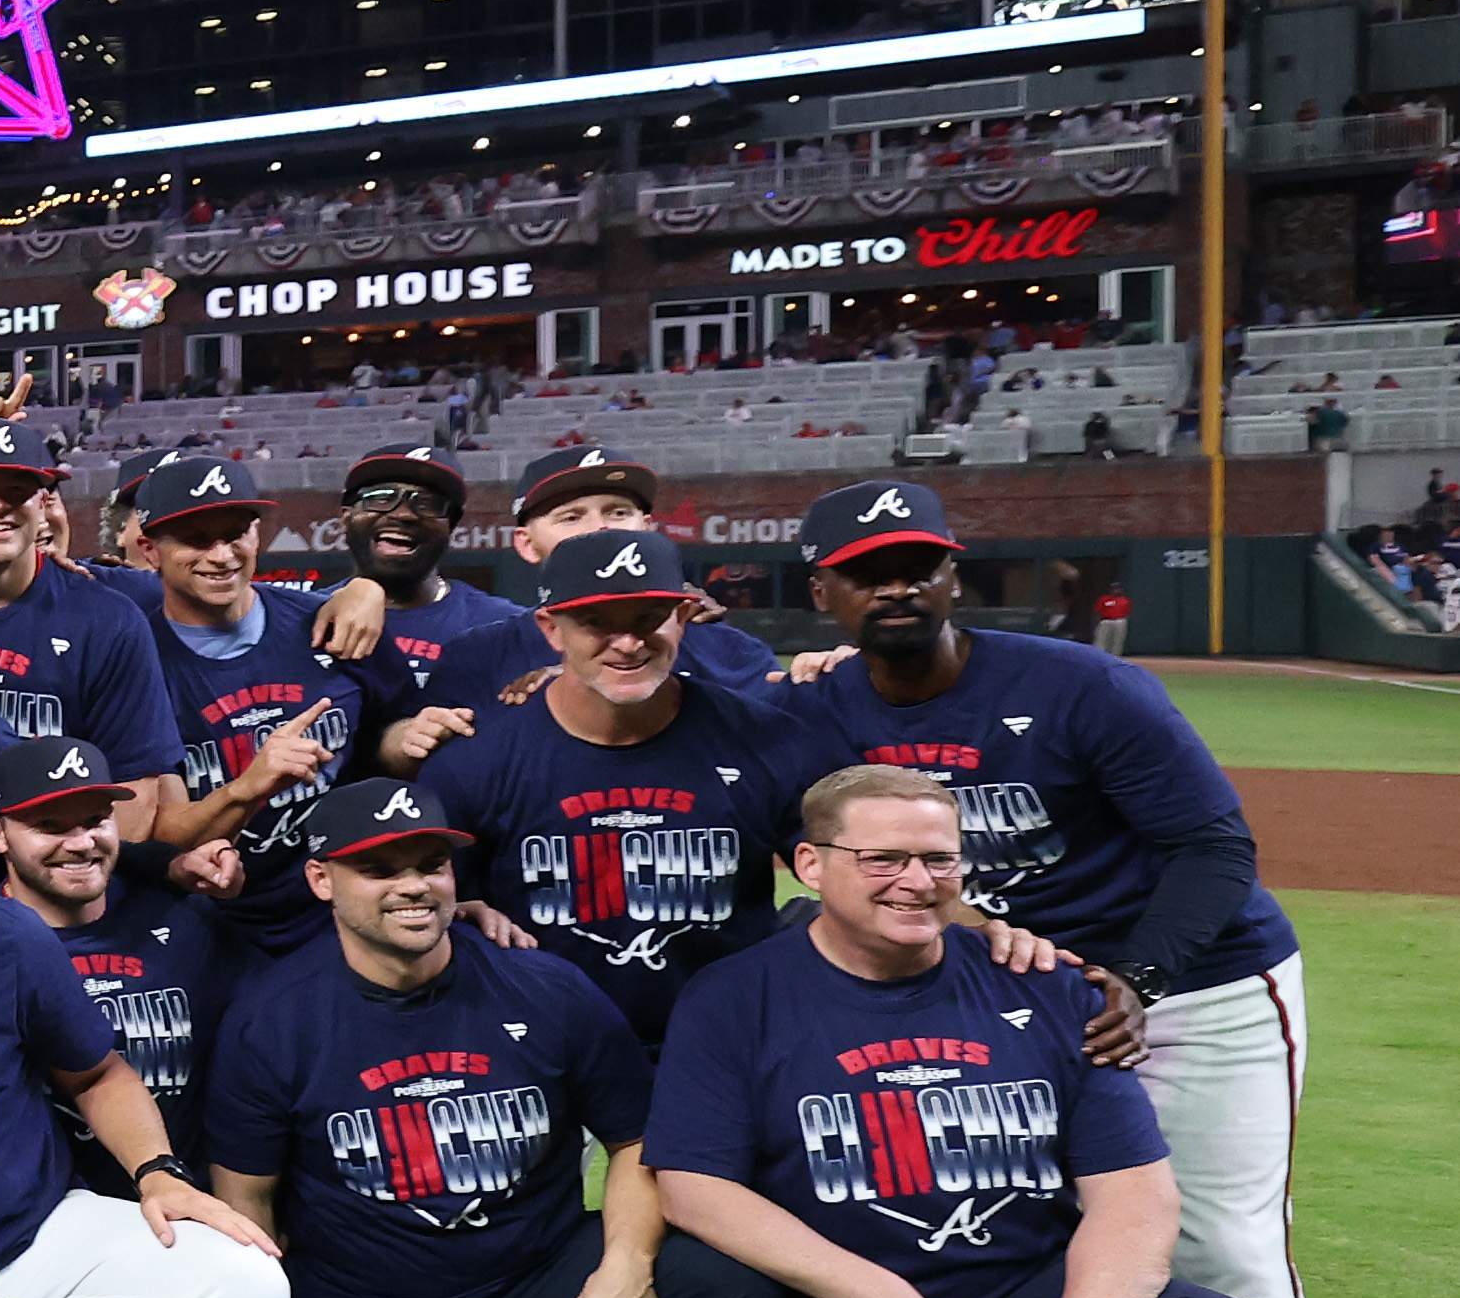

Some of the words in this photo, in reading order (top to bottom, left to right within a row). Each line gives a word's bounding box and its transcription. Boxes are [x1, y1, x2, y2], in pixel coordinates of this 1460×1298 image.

[729, 241, 844, 275] MADE
[850, 237, 908, 266] TO
[915, 207, 1099, 269] Chill
[204, 276, 340, 320] CHOP
[354, 261, 535, 310] HOUSE
[450, 524, 515, 551] GHT
[200, 682, 305, 724] BRAVES
[560, 787, 696, 821] BRAVES
[521, 826, 741, 928] CLINCHED
[359, 1051, 491, 1092] BRAVES
[836, 1038, 992, 1075] BRAVES
[877, 1063, 961, 1086] POSTSEASON
[327, 1085, 551, 1203] CLINCHED
[797, 1079, 1065, 1203] CLINCHED
